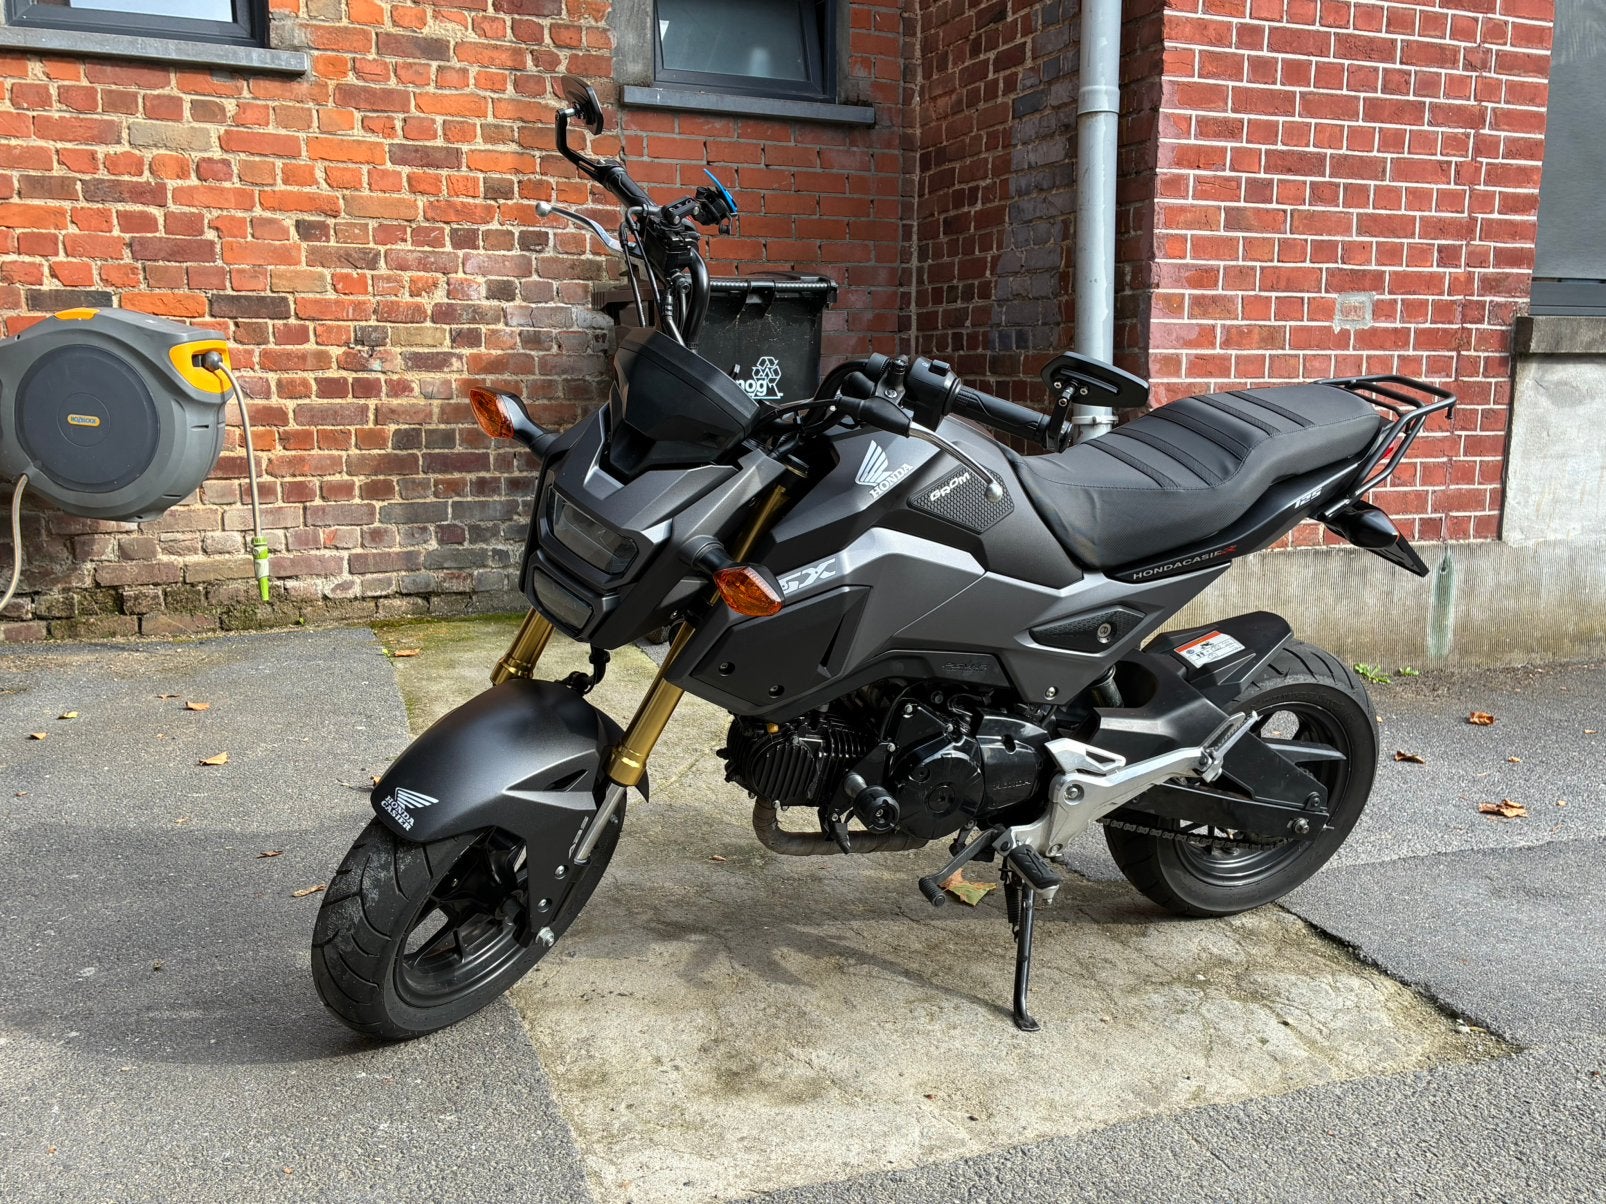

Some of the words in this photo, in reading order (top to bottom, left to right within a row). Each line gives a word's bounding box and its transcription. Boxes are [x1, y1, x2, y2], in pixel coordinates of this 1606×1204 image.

[869, 463, 914, 499] HONDA
[381, 800, 412, 832] CASIER
[385, 795, 415, 827] HONDA
